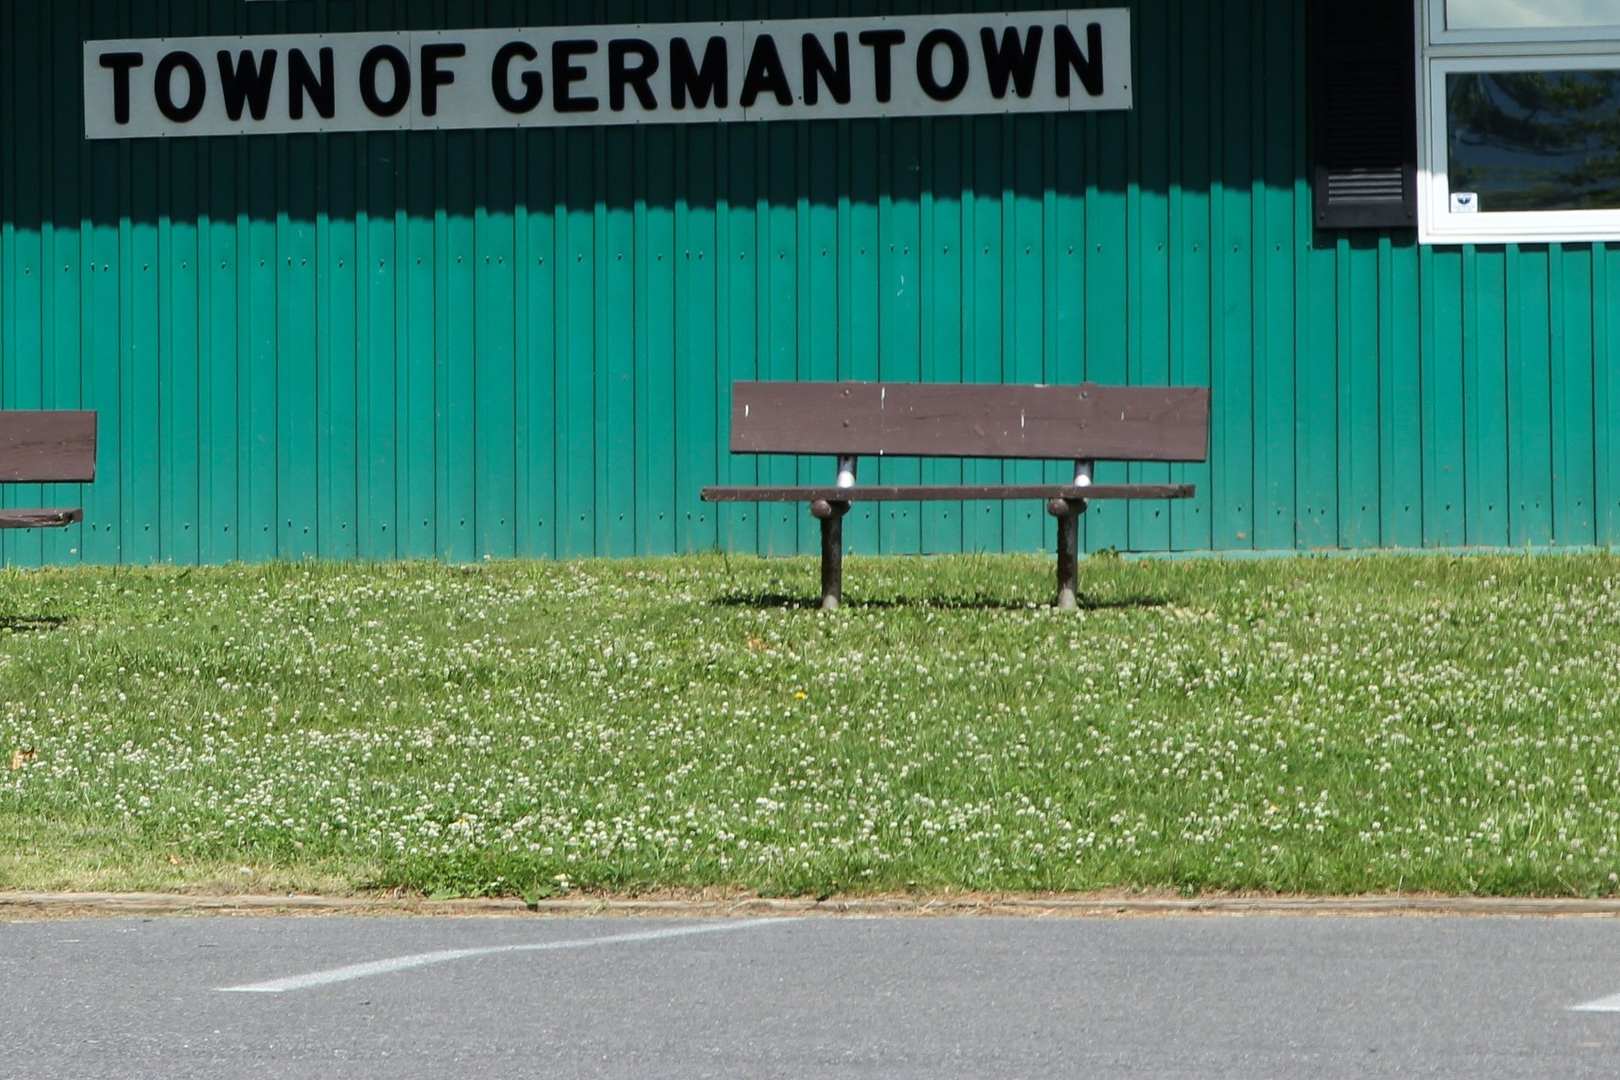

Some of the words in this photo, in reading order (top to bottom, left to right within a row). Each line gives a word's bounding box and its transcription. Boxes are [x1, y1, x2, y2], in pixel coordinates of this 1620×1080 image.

[98, 46, 336, 125] TOWN
[359, 43, 466, 118] OF
[491, 22, 1104, 115] GERMANTOWN
